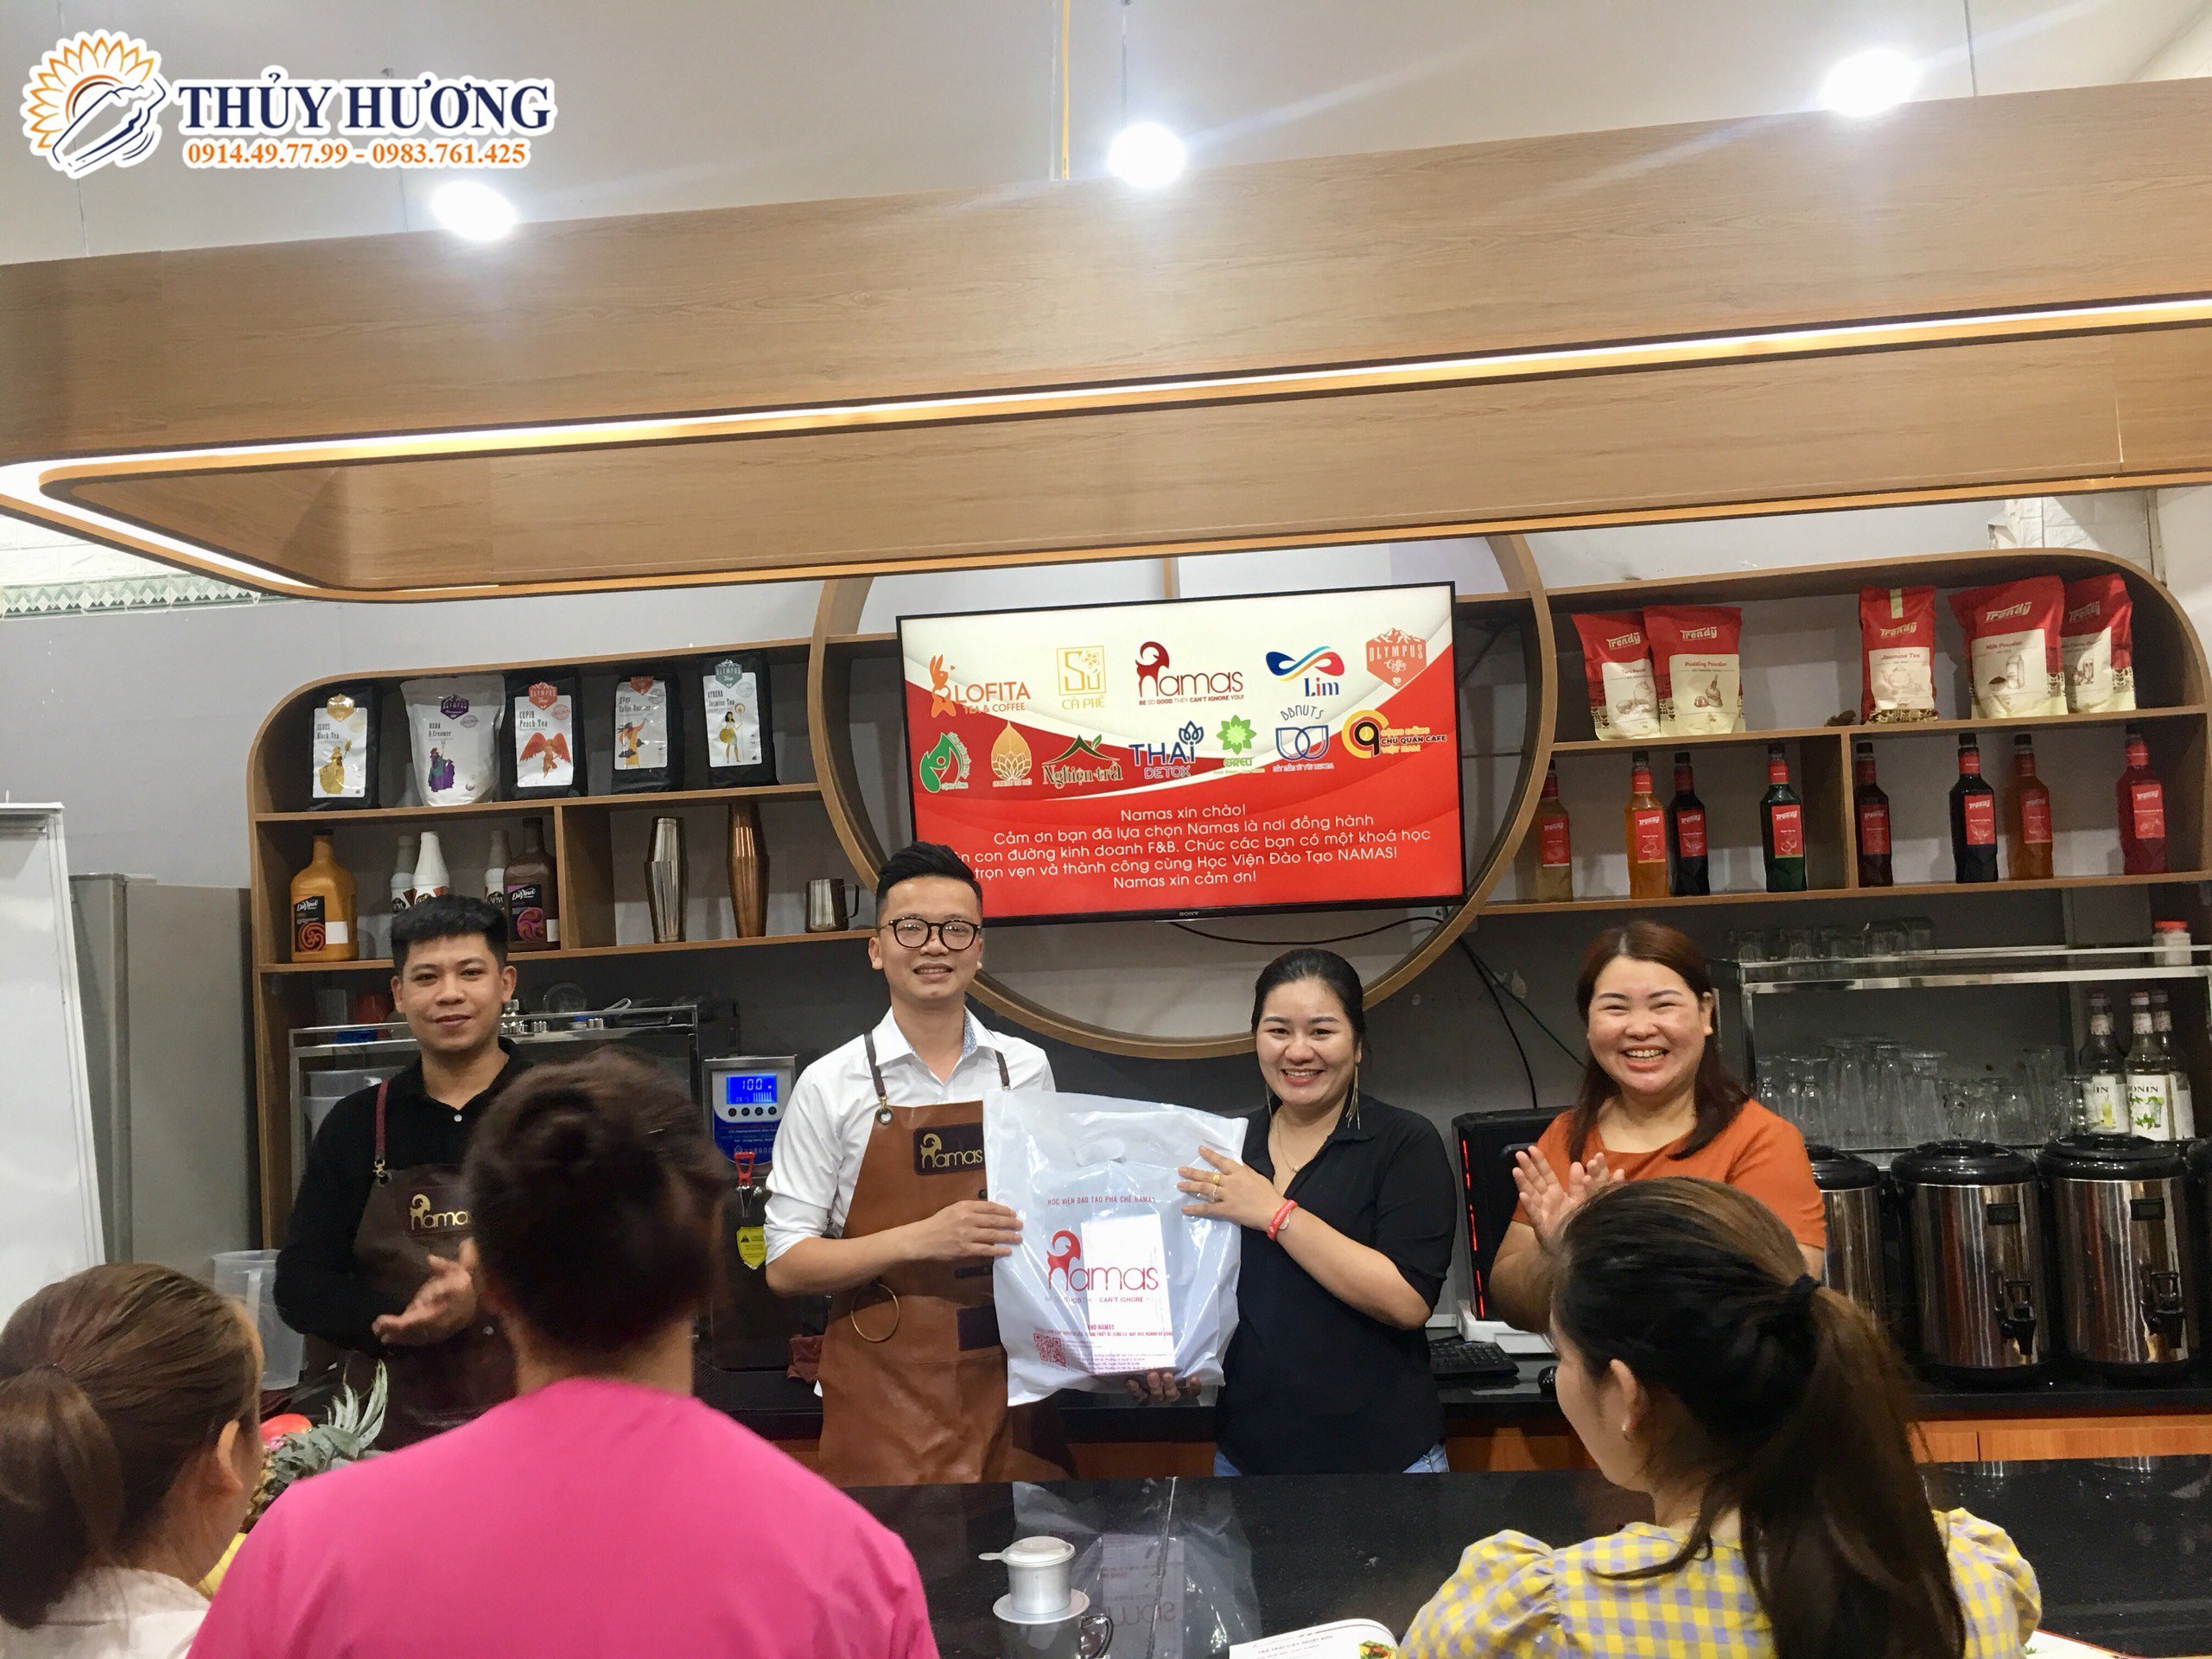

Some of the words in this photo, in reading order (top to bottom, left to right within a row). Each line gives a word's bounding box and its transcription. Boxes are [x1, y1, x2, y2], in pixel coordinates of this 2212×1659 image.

[1605, 632, 1641, 649] Trendy
[1680, 626, 1718, 640] Trendy
[1369, 645, 1423, 663] OLYMPUS
[954, 682, 1032, 704] LOFITA
[1304, 677, 1339, 697] Lim
[993, 702, 1026, 713] COFFEE
[1144, 765, 1192, 779] DETOX
[1121, 809, 1173, 822] Namas
[1177, 807, 1198, 819] xin
[1202, 804, 1246, 818] chào!
[994, 830, 1030, 846] Cảm
[1034, 832, 1053, 843] ơn
[1058, 829, 1088, 844] bạn
[1091, 827, 1113, 841] đã
[1116, 826, 1141, 841] lựa
[1144, 823, 1183, 839] chọn
[1187, 821, 1240, 836] Namas
[1243, 820, 1258, 833] là
[1262, 818, 1286, 831] nơi
[1290, 815, 1331, 831] đồng
[1335, 814, 1374, 828] hành
[975, 851, 1003, 863] con
[1007, 848, 1056, 864] đường
[1060, 846, 1090, 859] kinh
[1094, 843, 1143, 857] doanh
[1147, 841, 1179, 854] F&B.
[1185, 837, 1225, 853] Chúc
[1230, 836, 1260, 850] các
[1264, 834, 1295, 849] bạn
[1300, 832, 1319, 847] có
[1324, 832, 1354, 847] một
[1358, 829, 1396, 843] khoá
[1401, 828, 1432, 843] học
[975, 867, 1003, 880] trọn
[1007, 866, 1035, 879] vẹn
[1039, 863, 1058, 876] và
[1063, 860, 1106, 874] thành
[1110, 858, 1150, 874] công
[1154, 855, 1192, 871] cùng
[1197, 855, 1227, 869] Học
[1231, 853, 1265, 868] Viện
[1268, 850, 1301, 865] Đào
[1305, 850, 1333, 864] Tạo
[1338, 846, 1398, 861] NAMAS!
[1113, 875, 1166, 889] Namas
[1169, 874, 1190, 886] xin
[1194, 870, 1228, 886] cảm
[1233, 870, 1256, 884] ơn!
[741, 1077, 763, 1091] 100
